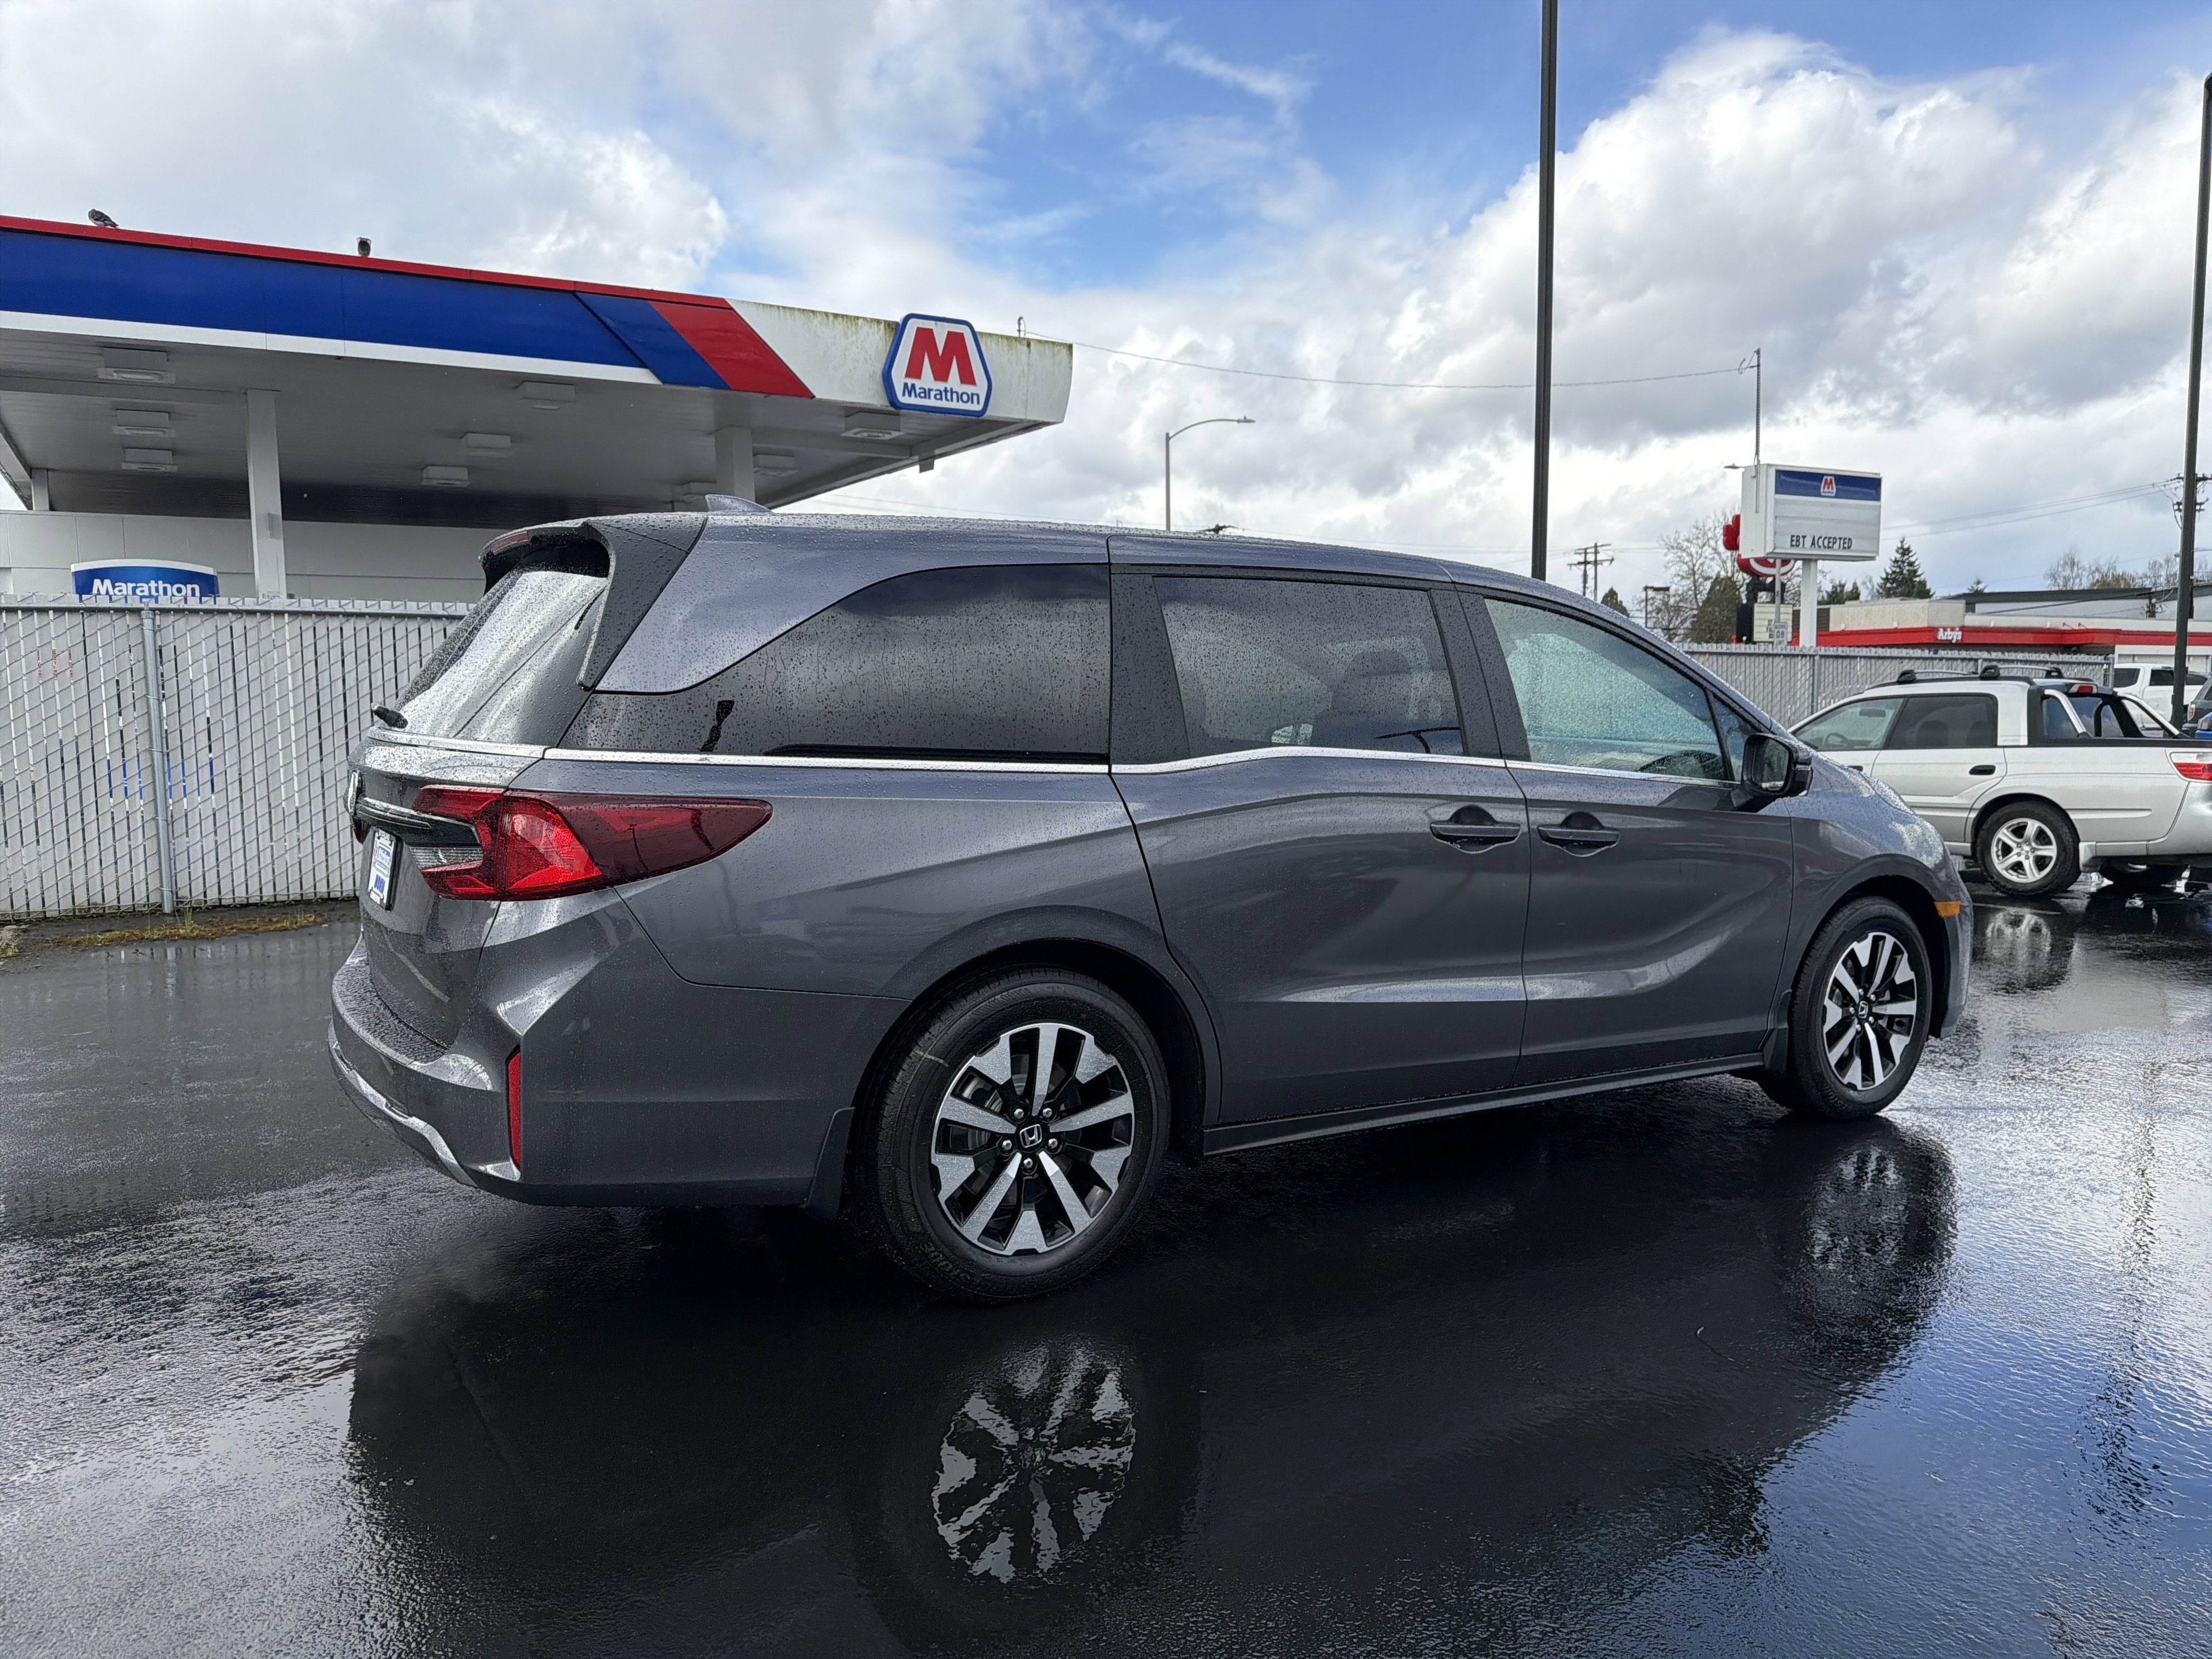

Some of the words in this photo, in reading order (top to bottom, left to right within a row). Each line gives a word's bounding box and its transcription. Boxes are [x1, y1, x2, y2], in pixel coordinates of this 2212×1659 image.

[905, 326, 977, 386] M
[902, 382, 980, 405] Marathon
[1822, 478, 1834, 490] M
[1790, 535, 1806, 548] EBT
[1810, 535, 1852, 549] ACCEPTED
[93, 579, 200, 597] Marathon
[1938, 628, 1962, 643] Arby's
